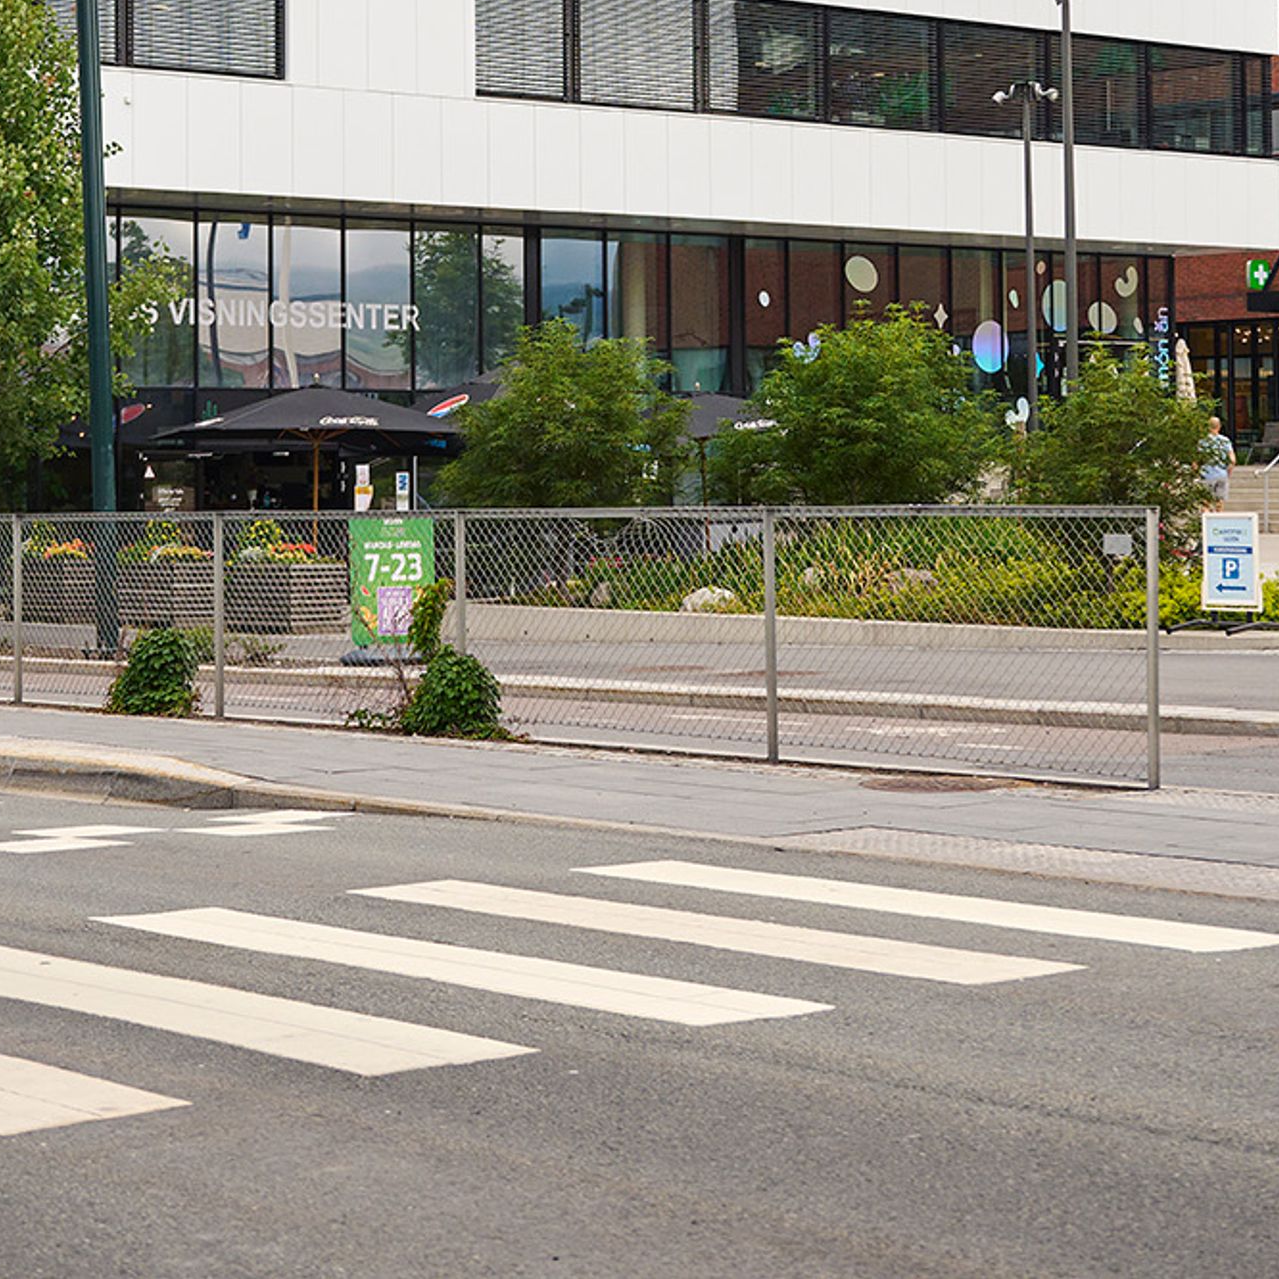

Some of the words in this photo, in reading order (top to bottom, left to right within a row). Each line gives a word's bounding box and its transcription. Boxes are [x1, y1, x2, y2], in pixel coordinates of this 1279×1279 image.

[169, 297, 420, 332] VISNINGSSENTER
[364, 552, 423, 582] 7-23
[1225, 560, 1237, 578] P
